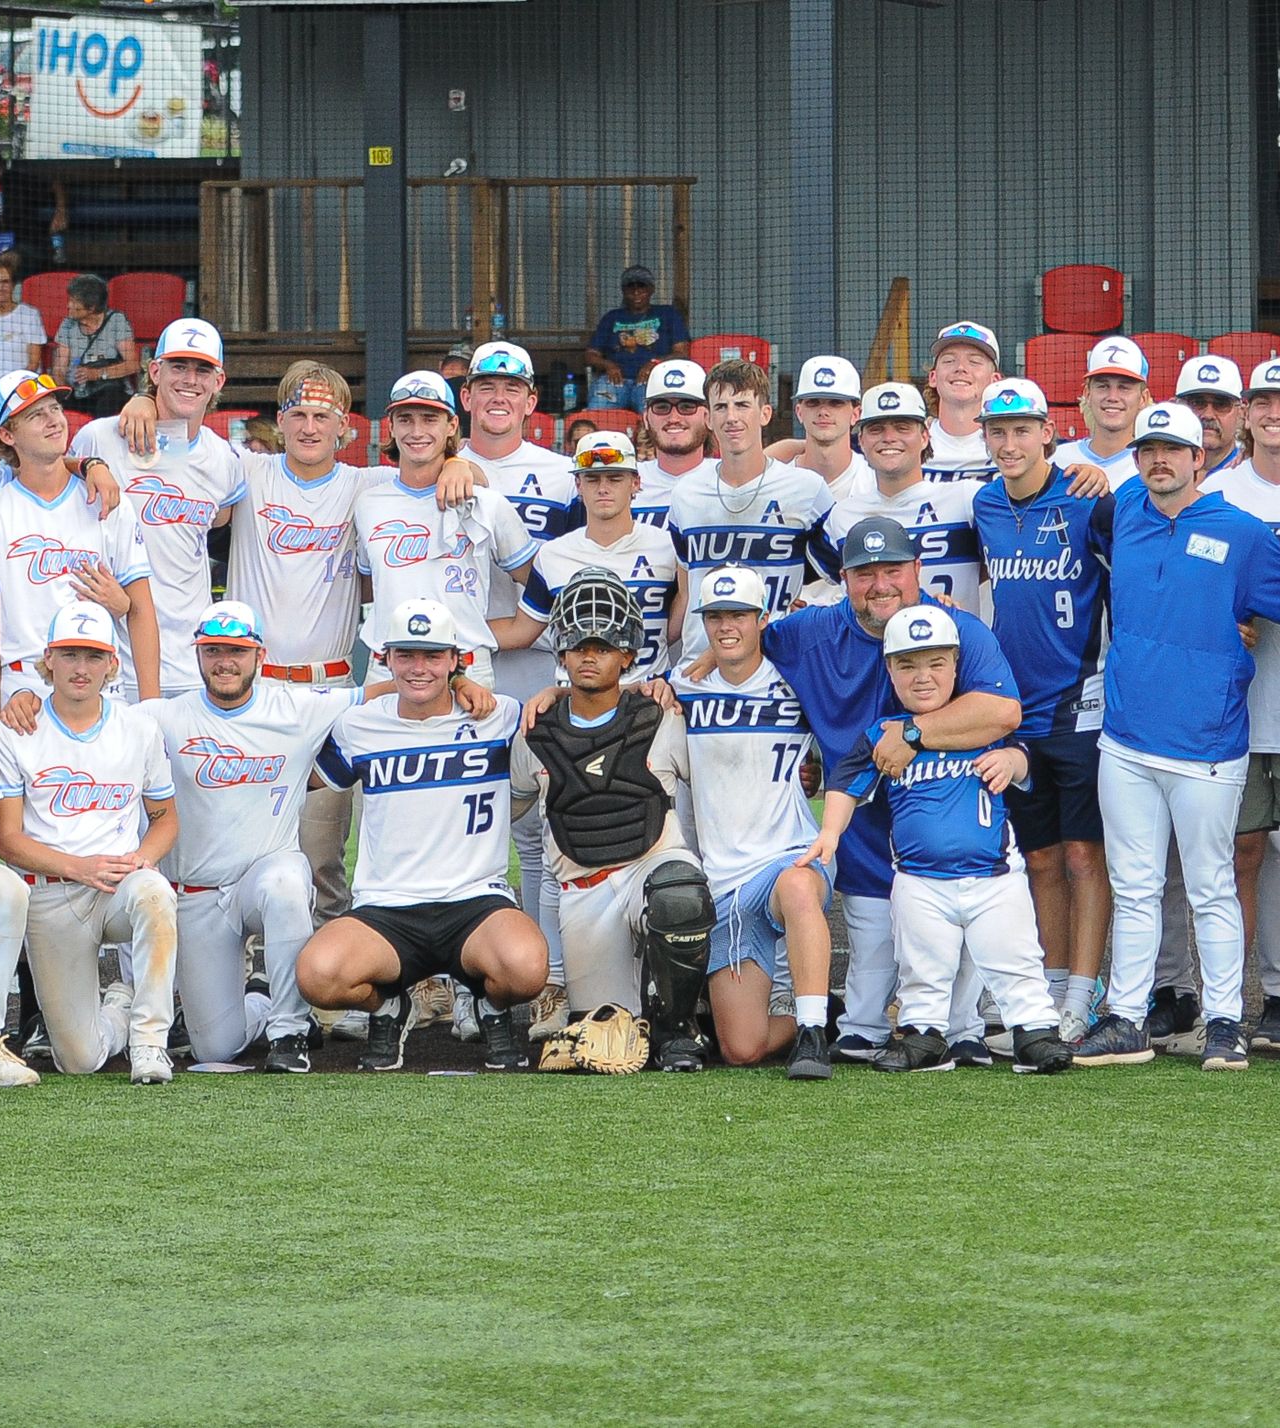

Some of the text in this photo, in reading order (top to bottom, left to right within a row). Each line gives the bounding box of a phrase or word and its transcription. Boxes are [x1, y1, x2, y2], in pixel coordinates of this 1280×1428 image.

[124, 475, 216, 527] TROPICS
[257, 503, 349, 555] TROPICS
[687, 532, 796, 561] NUTS
[322, 554, 354, 585] 14
[445, 564, 477, 597] 22
[1055, 589, 1074, 630] 9
[687, 700, 804, 728] NUTS
[178, 736, 286, 790] TROPICS
[367, 747, 489, 788] NUTS
[32, 765, 134, 818] TROPICS
[269, 785, 290, 817] 7
[463, 791, 495, 836] 15
